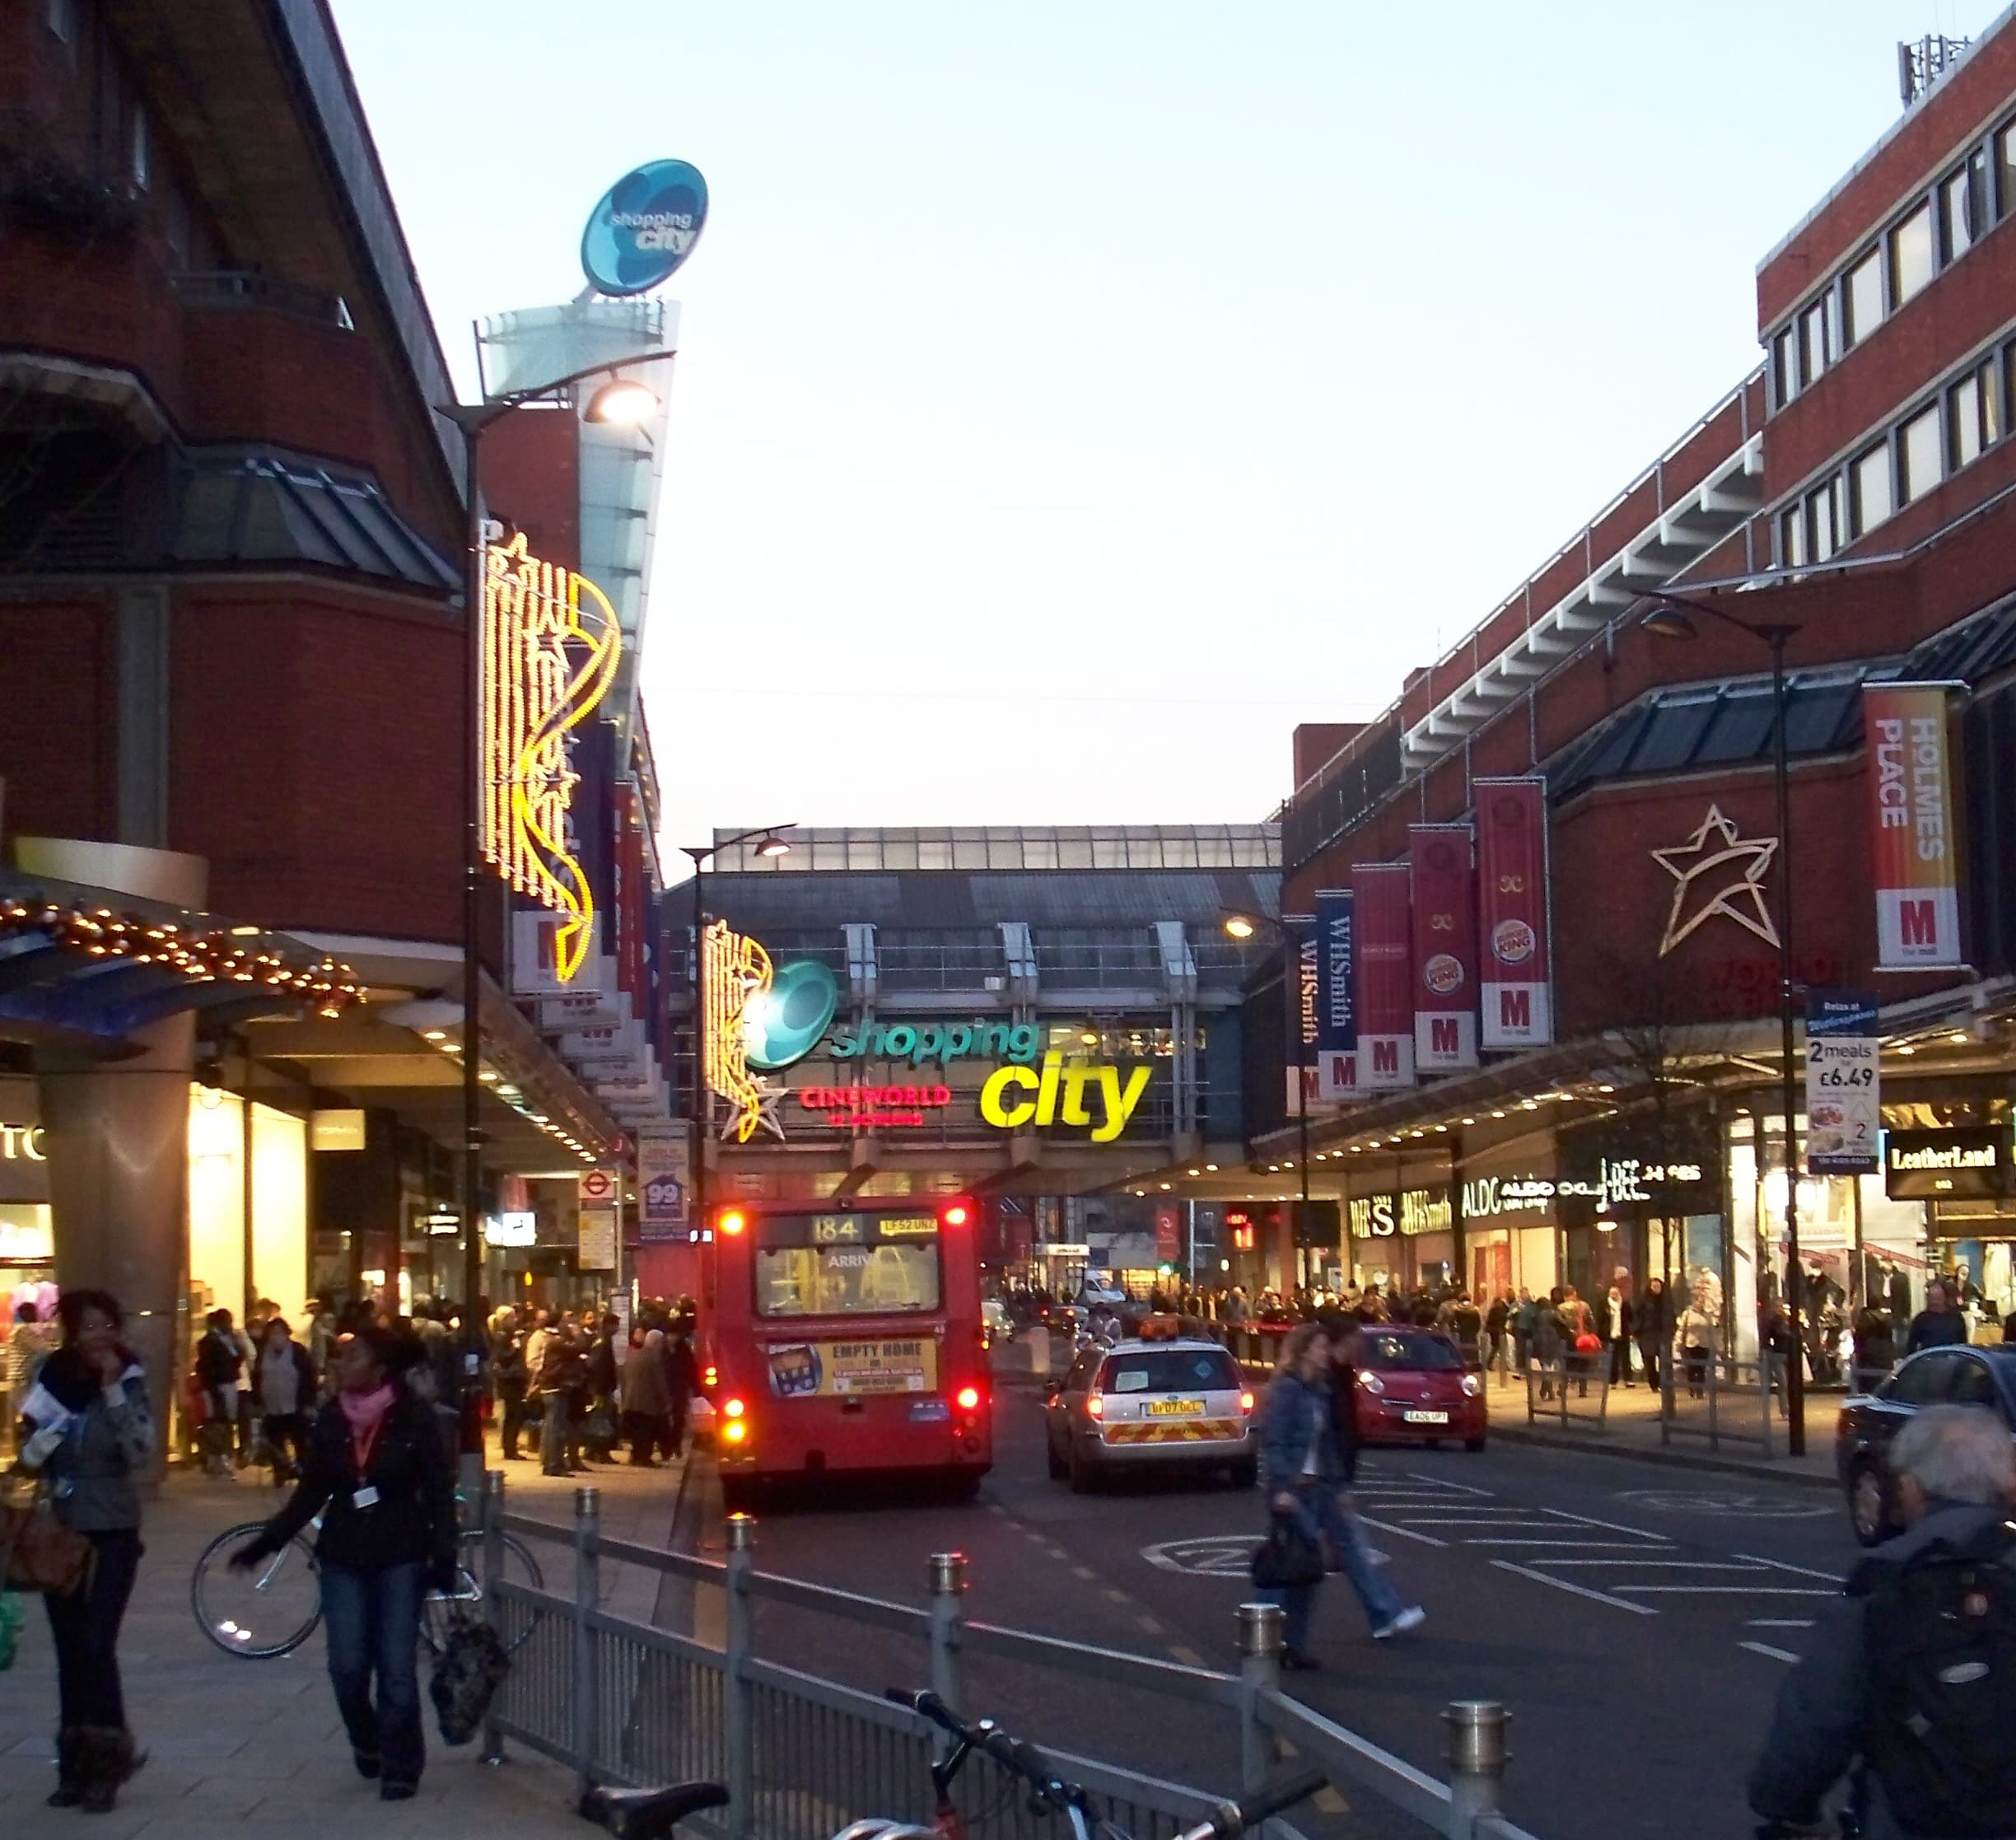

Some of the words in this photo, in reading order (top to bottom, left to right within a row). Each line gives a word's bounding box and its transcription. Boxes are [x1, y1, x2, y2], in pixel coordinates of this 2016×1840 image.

[610, 211, 693, 228] shopping
[635, 226, 698, 255] city
[1876, 718, 1907, 829] PLACE
[1910, 717, 1946, 862] HOLMES
[1900, 899, 1936, 946] M
[1500, 937, 1530, 952] KING
[1329, 916, 1351, 1027] WHSmith
[1300, 940, 1318, 1044] WHSmith
[1500, 990, 1529, 1026] M
[830, 1018, 1038, 1062] shopping
[1432, 1019, 1458, 1052] M
[1374, 1041, 1398, 1072] M
[1810, 1041, 1822, 1062] 2
[1825, 1044, 1872, 1058] meals
[1332, 1057, 1356, 1085] M
[1821, 1067, 1874, 1086] £6.49
[799, 1086, 951, 1108] CINEWORLD
[980, 1050, 1152, 1142] city
[1856, 1123, 1866, 1139] 2
[1892, 1144, 1995, 1170] LeatherLand
[646, 1184, 679, 1203] 99
[815, 1217, 859, 1241] 184
[833, 1344, 878, 1358] EMPTY
[883, 1343, 922, 1357] HOME
